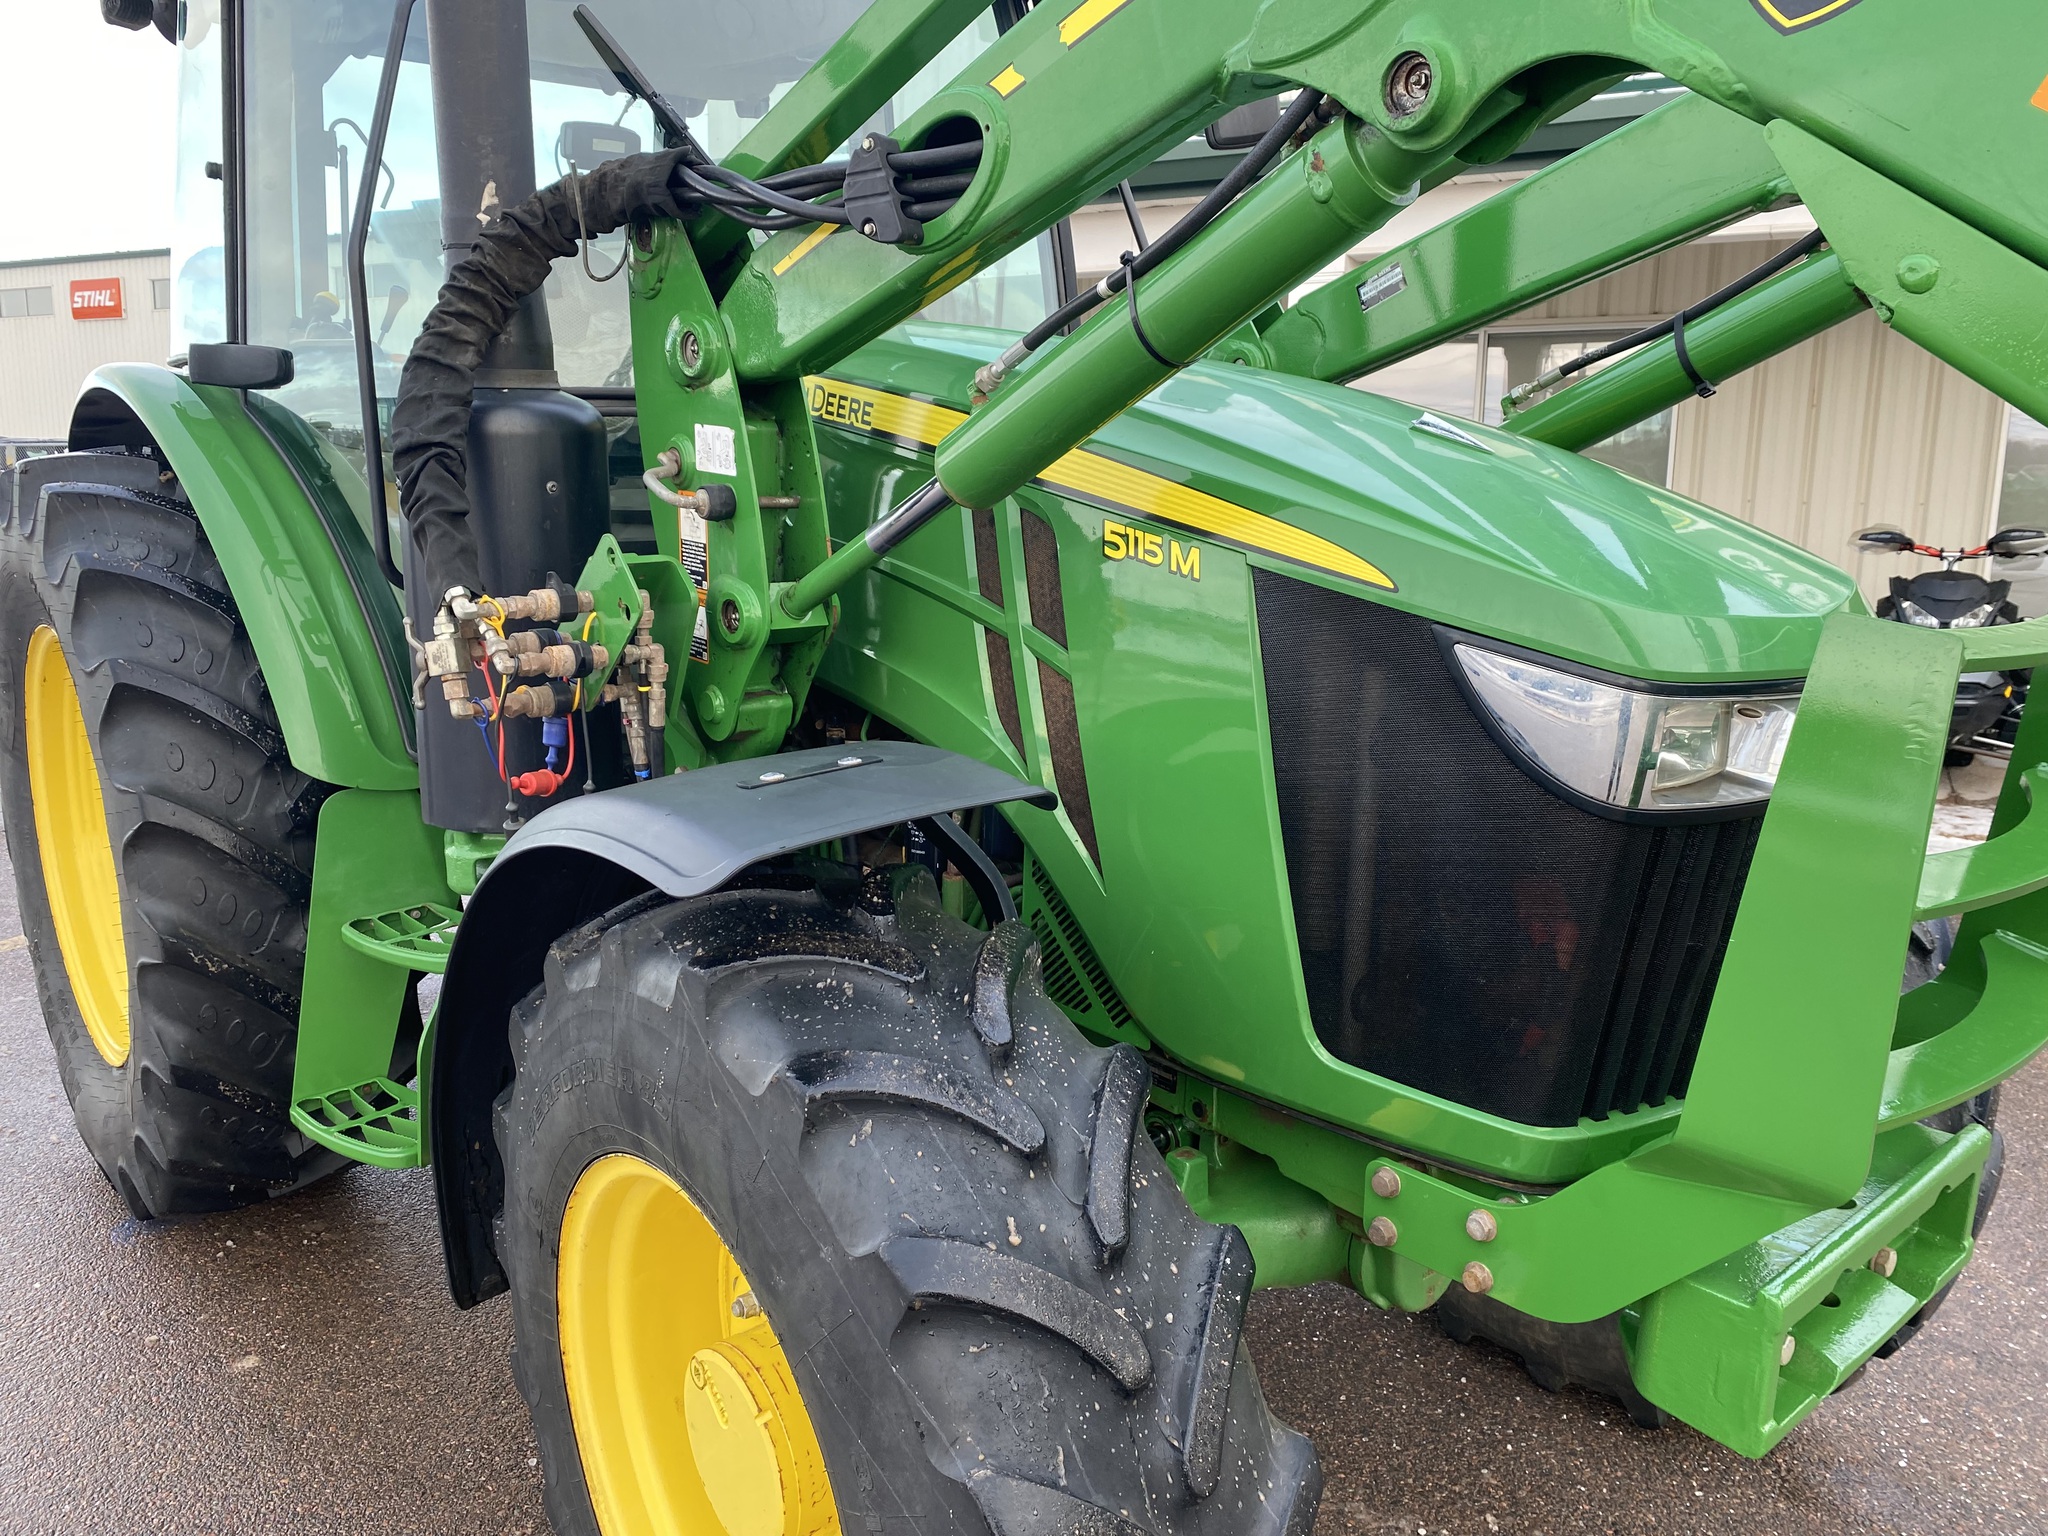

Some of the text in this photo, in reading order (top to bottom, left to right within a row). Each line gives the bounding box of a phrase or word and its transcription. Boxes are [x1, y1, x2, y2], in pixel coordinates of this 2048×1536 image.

[73, 290, 115, 308] STIHL
[811, 384, 874, 427] DEERE
[1103, 519, 1201, 582] 5115 M
